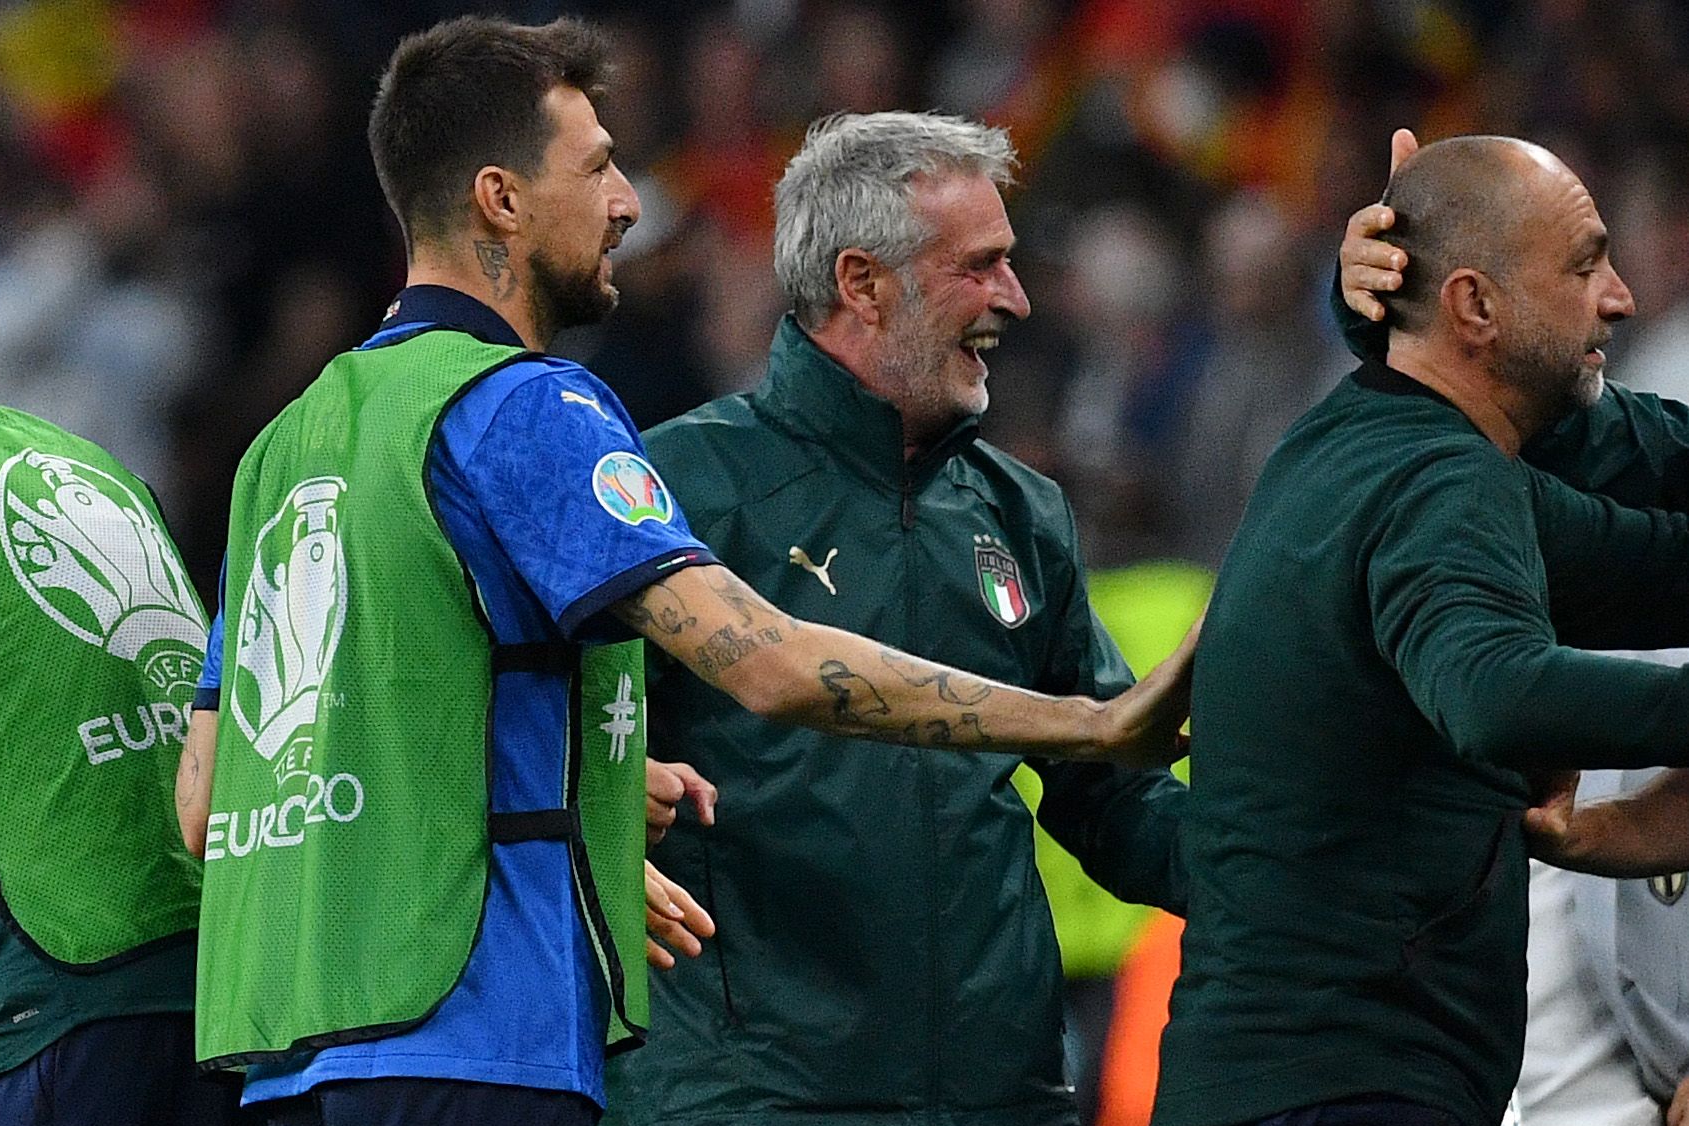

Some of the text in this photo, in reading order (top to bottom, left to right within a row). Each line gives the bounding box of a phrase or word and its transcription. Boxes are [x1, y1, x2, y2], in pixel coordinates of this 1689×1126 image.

[149, 658, 203, 688] UEF
[77, 702, 193, 765] EUR
[276, 745, 313, 789] UEF
